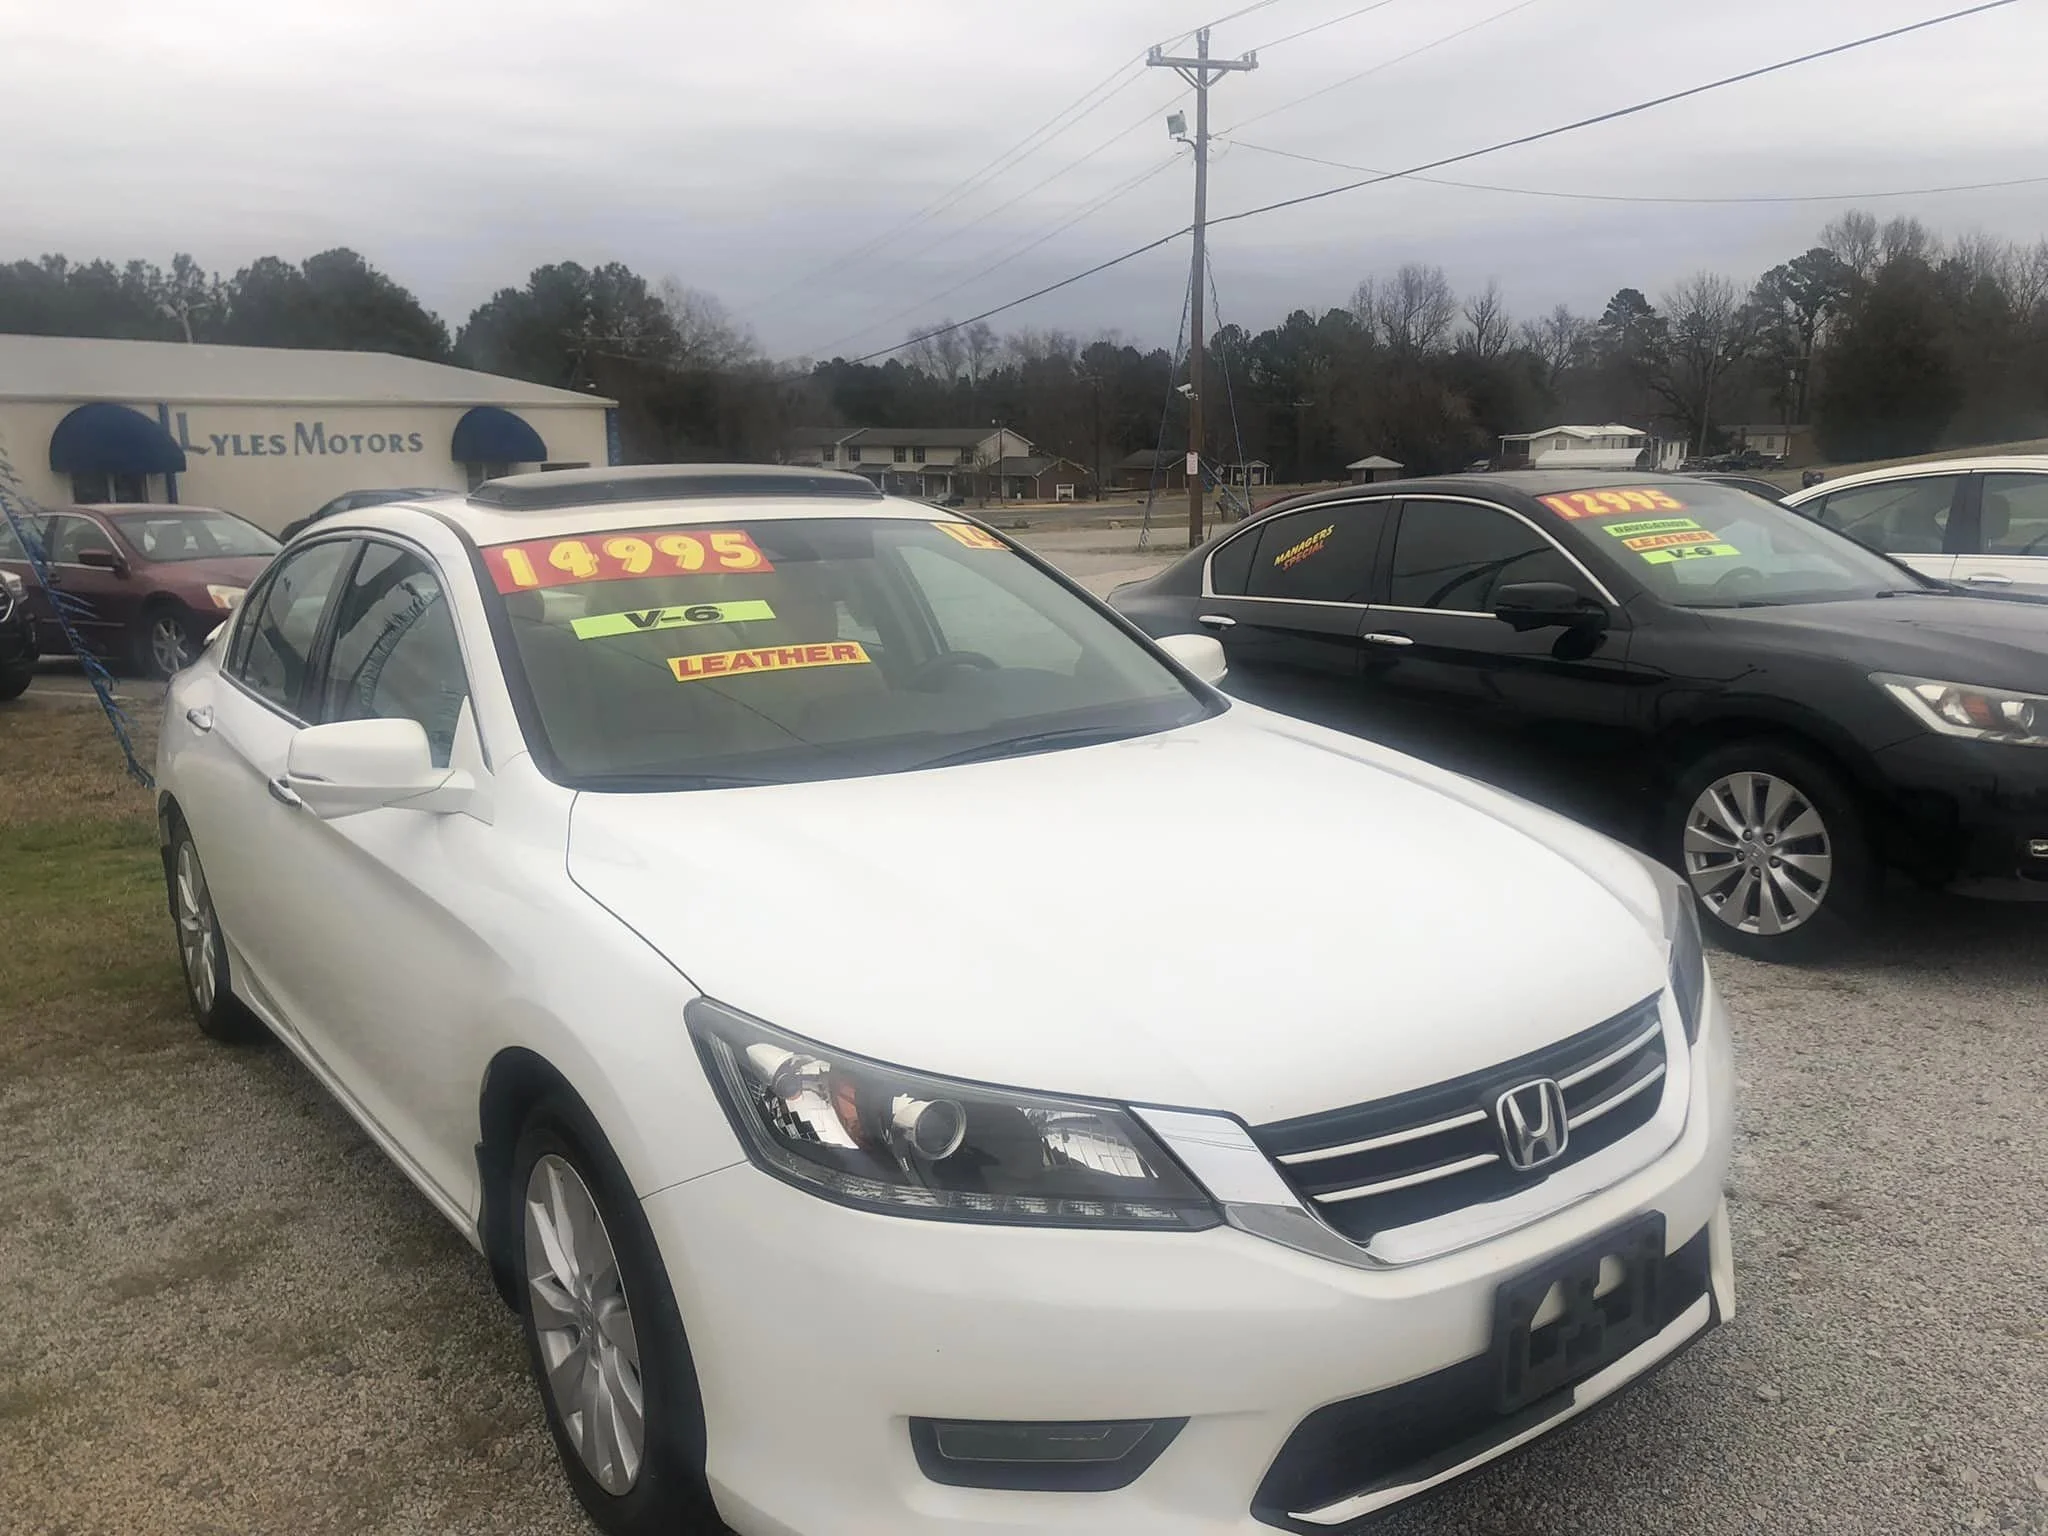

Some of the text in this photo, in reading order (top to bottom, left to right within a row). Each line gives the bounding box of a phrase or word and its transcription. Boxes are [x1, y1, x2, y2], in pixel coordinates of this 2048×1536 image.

[176, 412, 423, 456] LYLES MOTORS
[1546, 489, 1682, 517] 12995
[1274, 524, 1335, 567] MANAGERS
[1628, 533, 1714, 548] LEATHER
[1666, 546, 1713, 558] V-6
[502, 533, 761, 587] 14995
[624, 604, 724, 630] V-6
[678, 643, 858, 678] LEATHER
